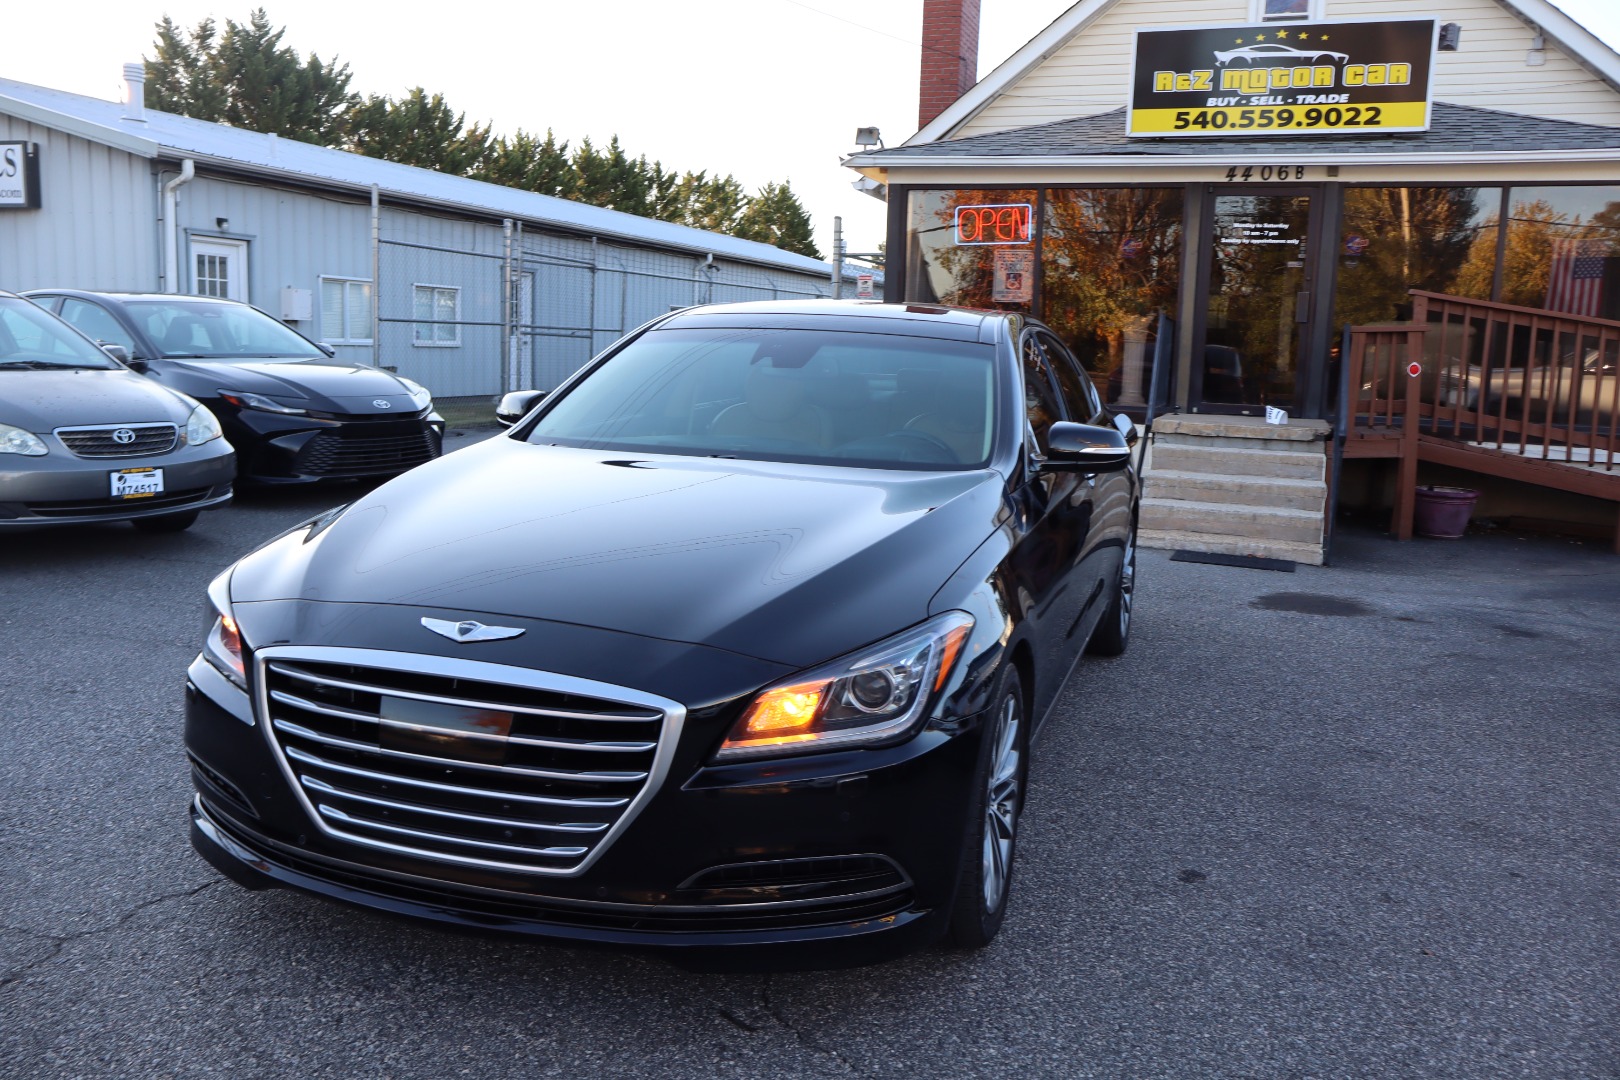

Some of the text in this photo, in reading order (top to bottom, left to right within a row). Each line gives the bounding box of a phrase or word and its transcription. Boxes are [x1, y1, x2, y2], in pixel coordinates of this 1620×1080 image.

[1206, 93, 1350, 107] BUY SELL TRADE
[1174, 106, 1382, 129] 540.559.9022
[1225, 165, 1304, 182] 4406B
[959, 207, 1029, 241] OPEN
[117, 483, 159, 494] M74517
